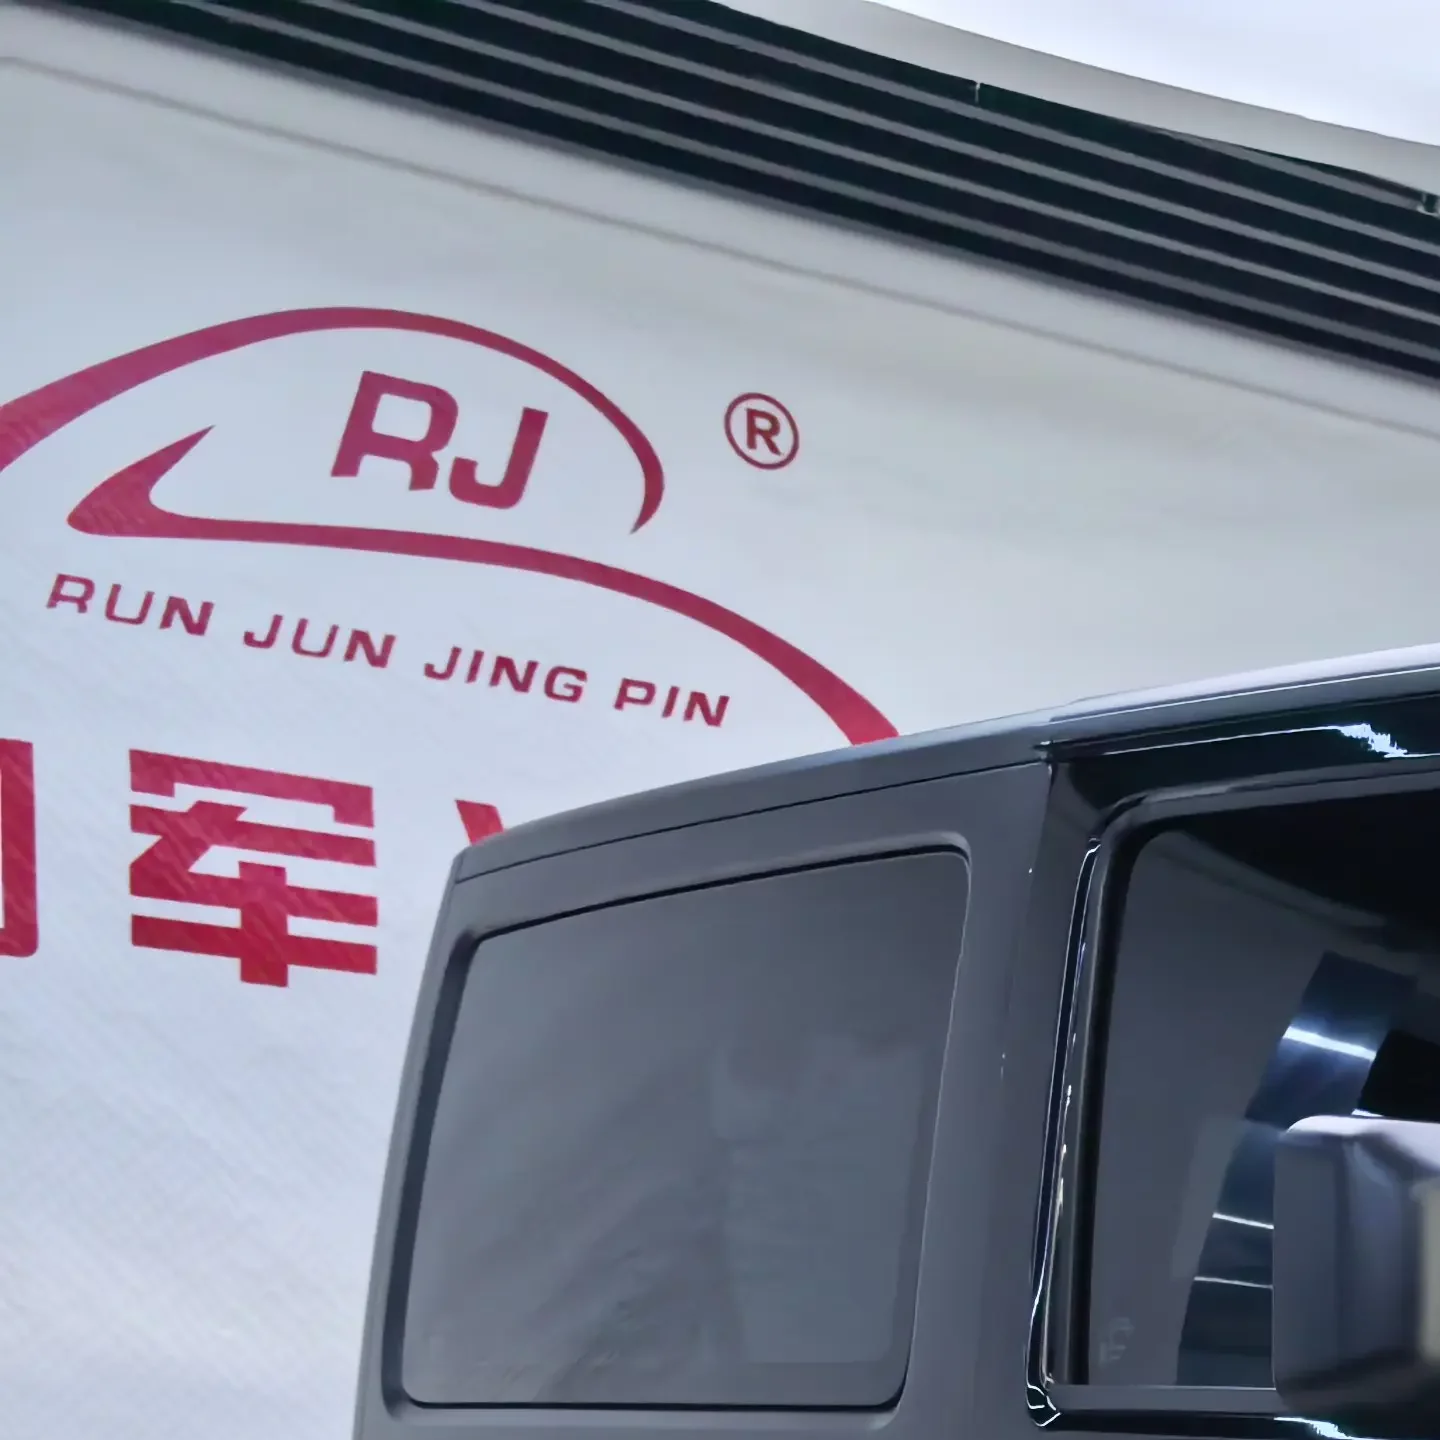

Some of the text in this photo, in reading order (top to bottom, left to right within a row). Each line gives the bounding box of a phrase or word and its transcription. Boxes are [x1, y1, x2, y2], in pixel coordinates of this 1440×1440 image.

[46, 572, 730, 729] RUN JUN JING PIN
